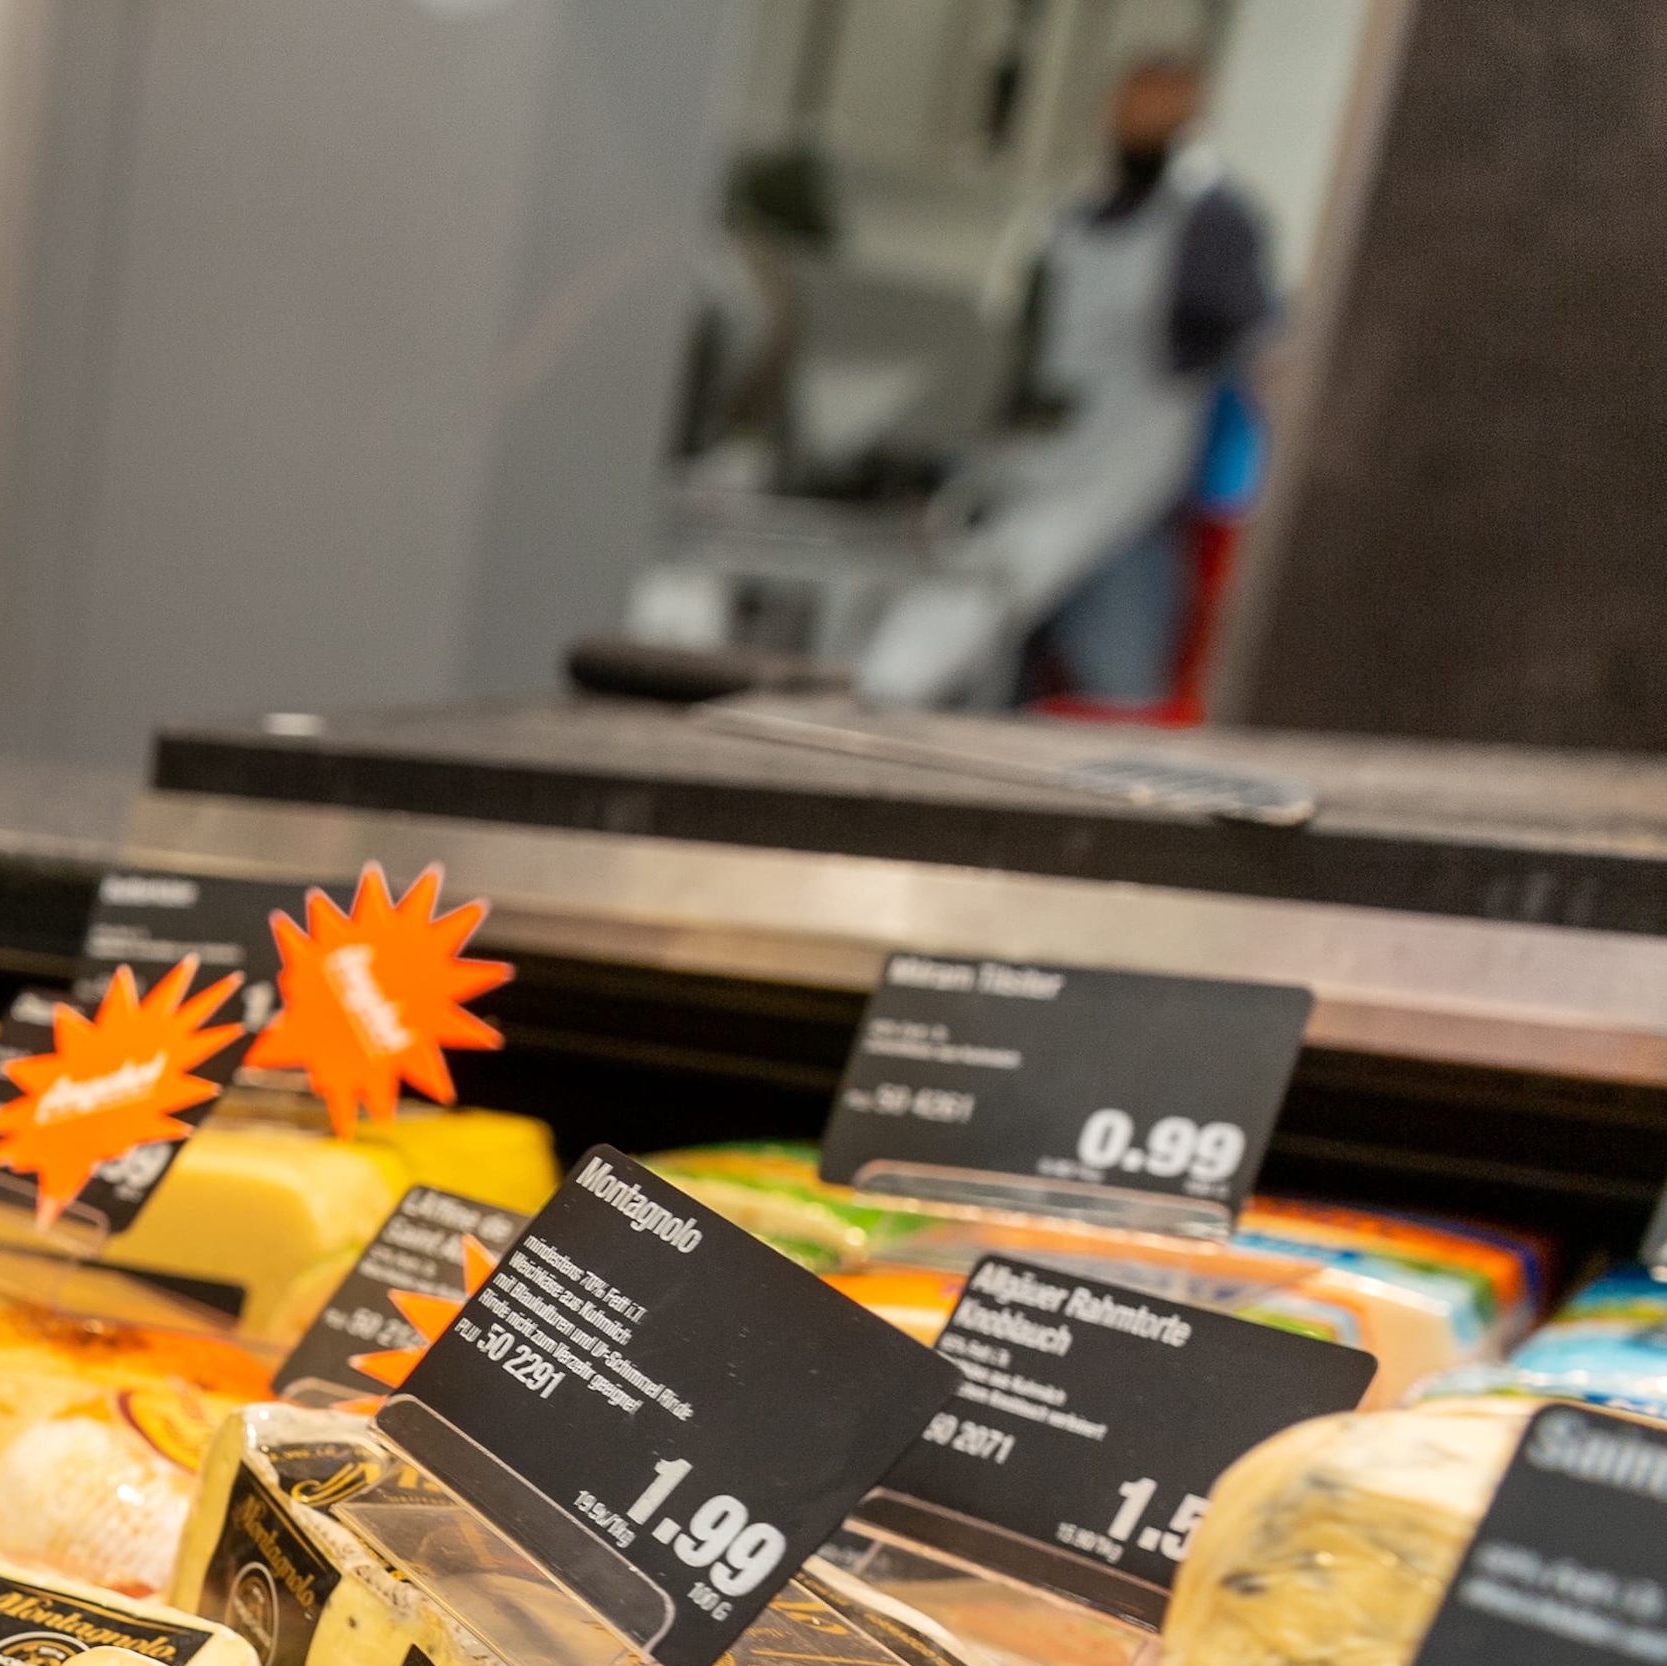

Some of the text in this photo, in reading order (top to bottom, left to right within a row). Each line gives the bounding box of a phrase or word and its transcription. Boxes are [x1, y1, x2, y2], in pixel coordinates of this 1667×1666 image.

[1076, 1107, 1247, 1181] 0.99
[576, 1155, 703, 1254] Montagnolo
[493, 1273, 517, 1292] mit
[510, 1282, 575, 1335] Blaukulturen
[570, 1329, 599, 1350] und
[509, 1251, 564, 1297] Weichkäse
[559, 1291, 583, 1311] aus
[524, 1236, 584, 1281] mindestens
[580, 1271, 609, 1298] 70%
[603, 1288, 631, 1312] Fett
[972, 1256, 1191, 1346] Allgäuer Rahmtorte
[455, 1318, 481, 1342] PLU
[477, 1323, 515, 1360] 50
[503, 1345, 565, 1398] 2291
[479, 1288, 511, 1318] Rinde
[506, 1312, 538, 1339] nicht
[530, 1330, 557, 1353] zum
[553, 1342, 596, 1380] Verzehr
[954, 1292, 1072, 1355] Knoblauch
[922, 1412, 1016, 1464] 50 2071
[625, 1457, 787, 1597] 1.99
[1107, 1477, 1209, 1561] 1.5
[687, 1582, 721, 1612] 100
